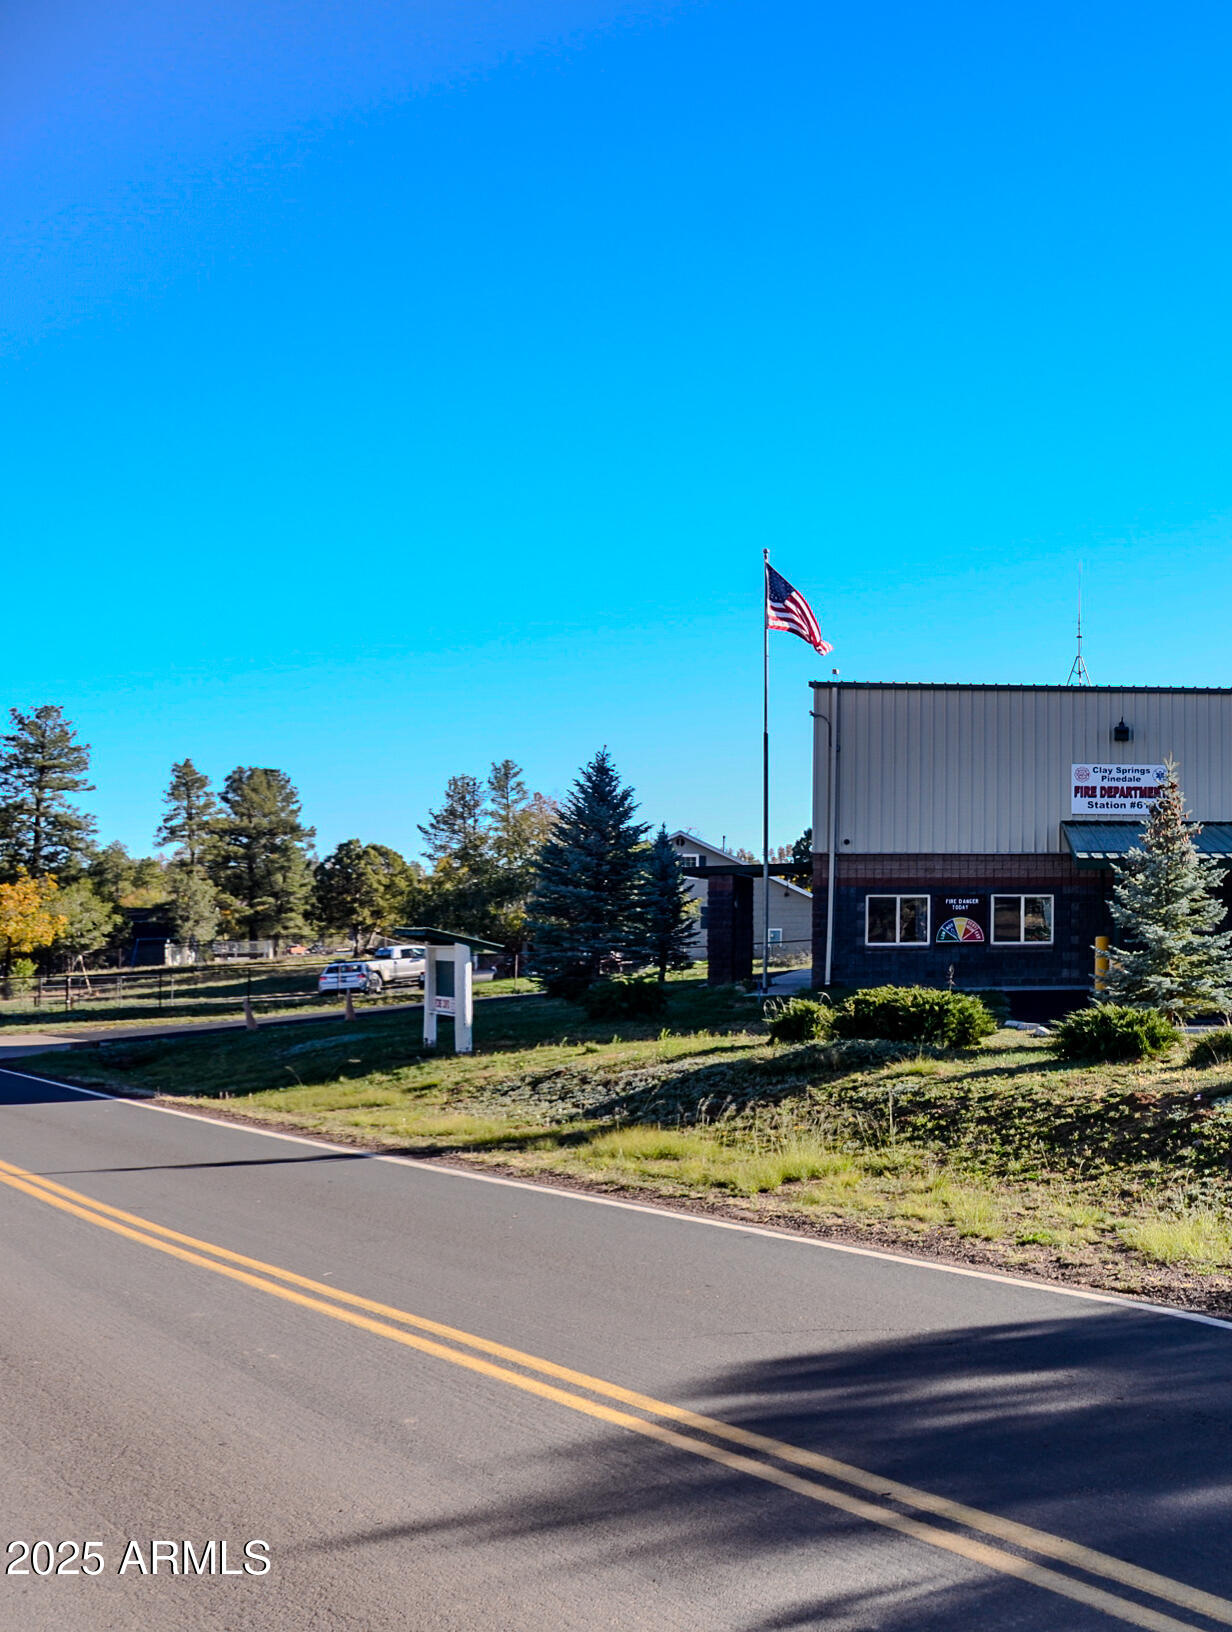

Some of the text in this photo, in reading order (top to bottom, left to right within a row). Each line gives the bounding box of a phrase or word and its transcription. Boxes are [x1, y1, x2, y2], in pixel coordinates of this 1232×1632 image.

[1092, 767, 1113, 775] Clay
[1116, 767, 1151, 775] Springs
[1101, 775, 1142, 783] Pinedale
[1074, 785, 1098, 799] FIRE
[1087, 800, 1127, 809] Station
